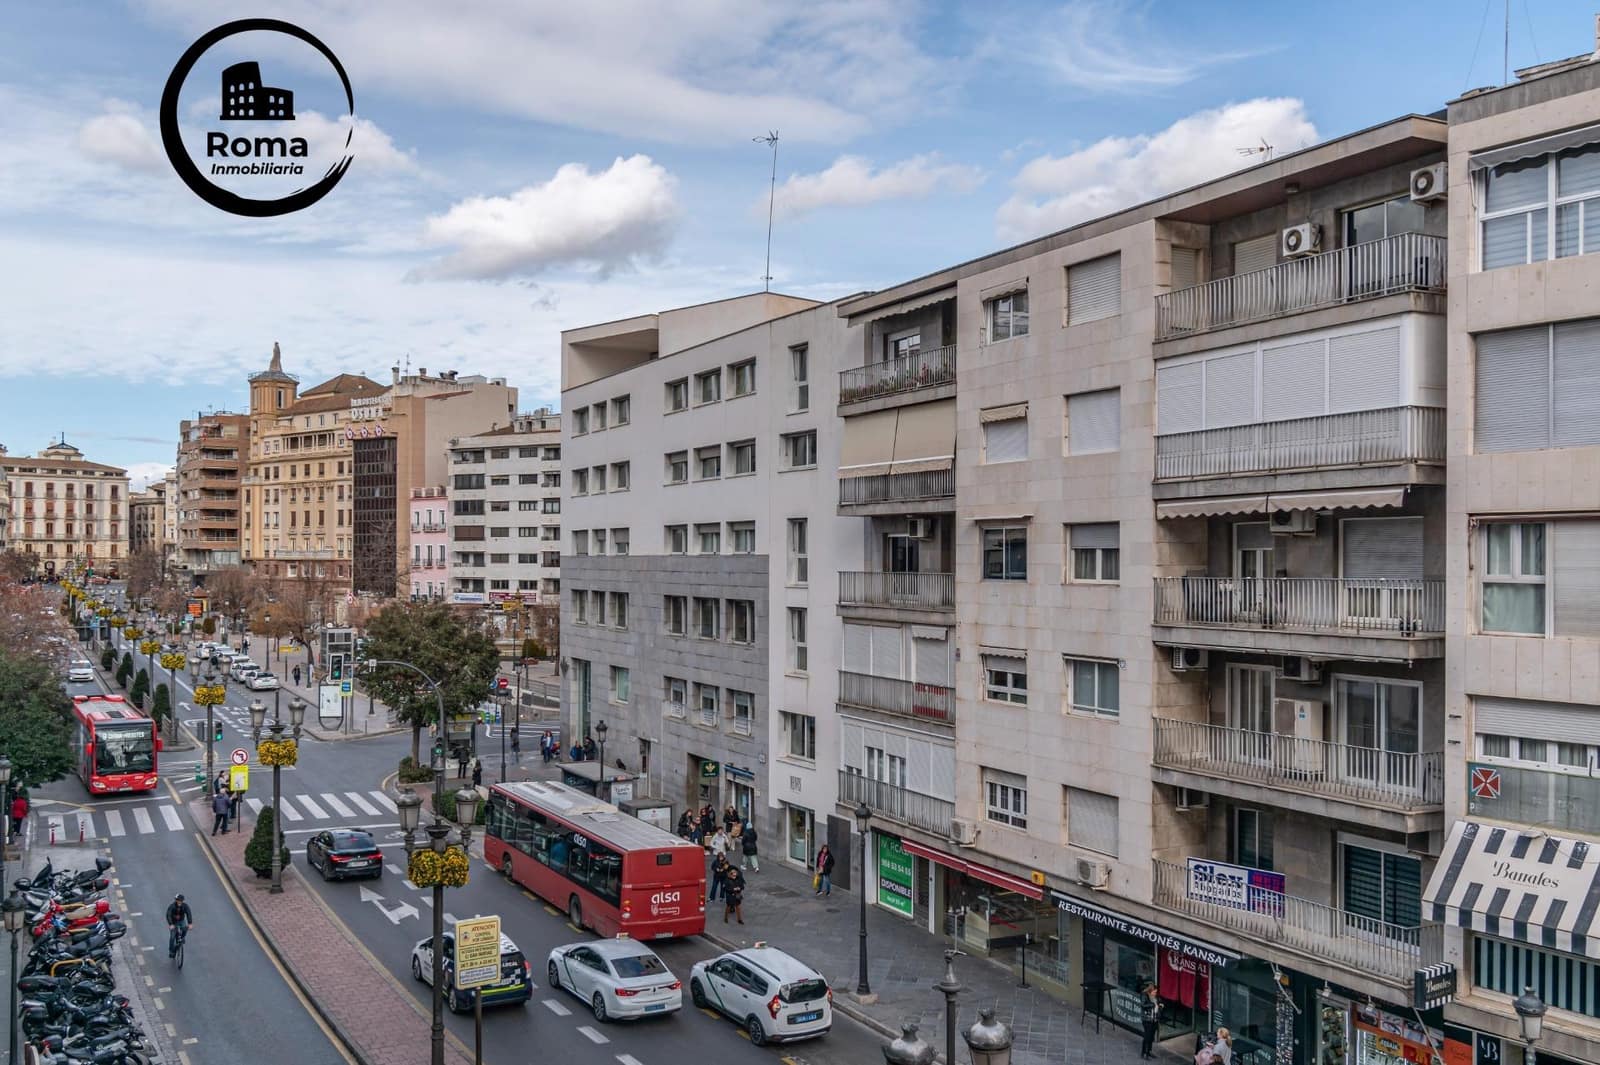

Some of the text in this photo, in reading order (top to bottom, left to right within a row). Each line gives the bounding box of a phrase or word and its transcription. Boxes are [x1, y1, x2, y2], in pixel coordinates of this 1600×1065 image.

[573, 833, 587, 848] alsa
[881, 878, 912, 897] DISPONIBLE
[651, 891, 680, 904] alsa
[1058, 900, 1226, 968] RESTAURANTE JAPONÉS KANSAI
[1173, 956, 1207, 973] KANSAI
